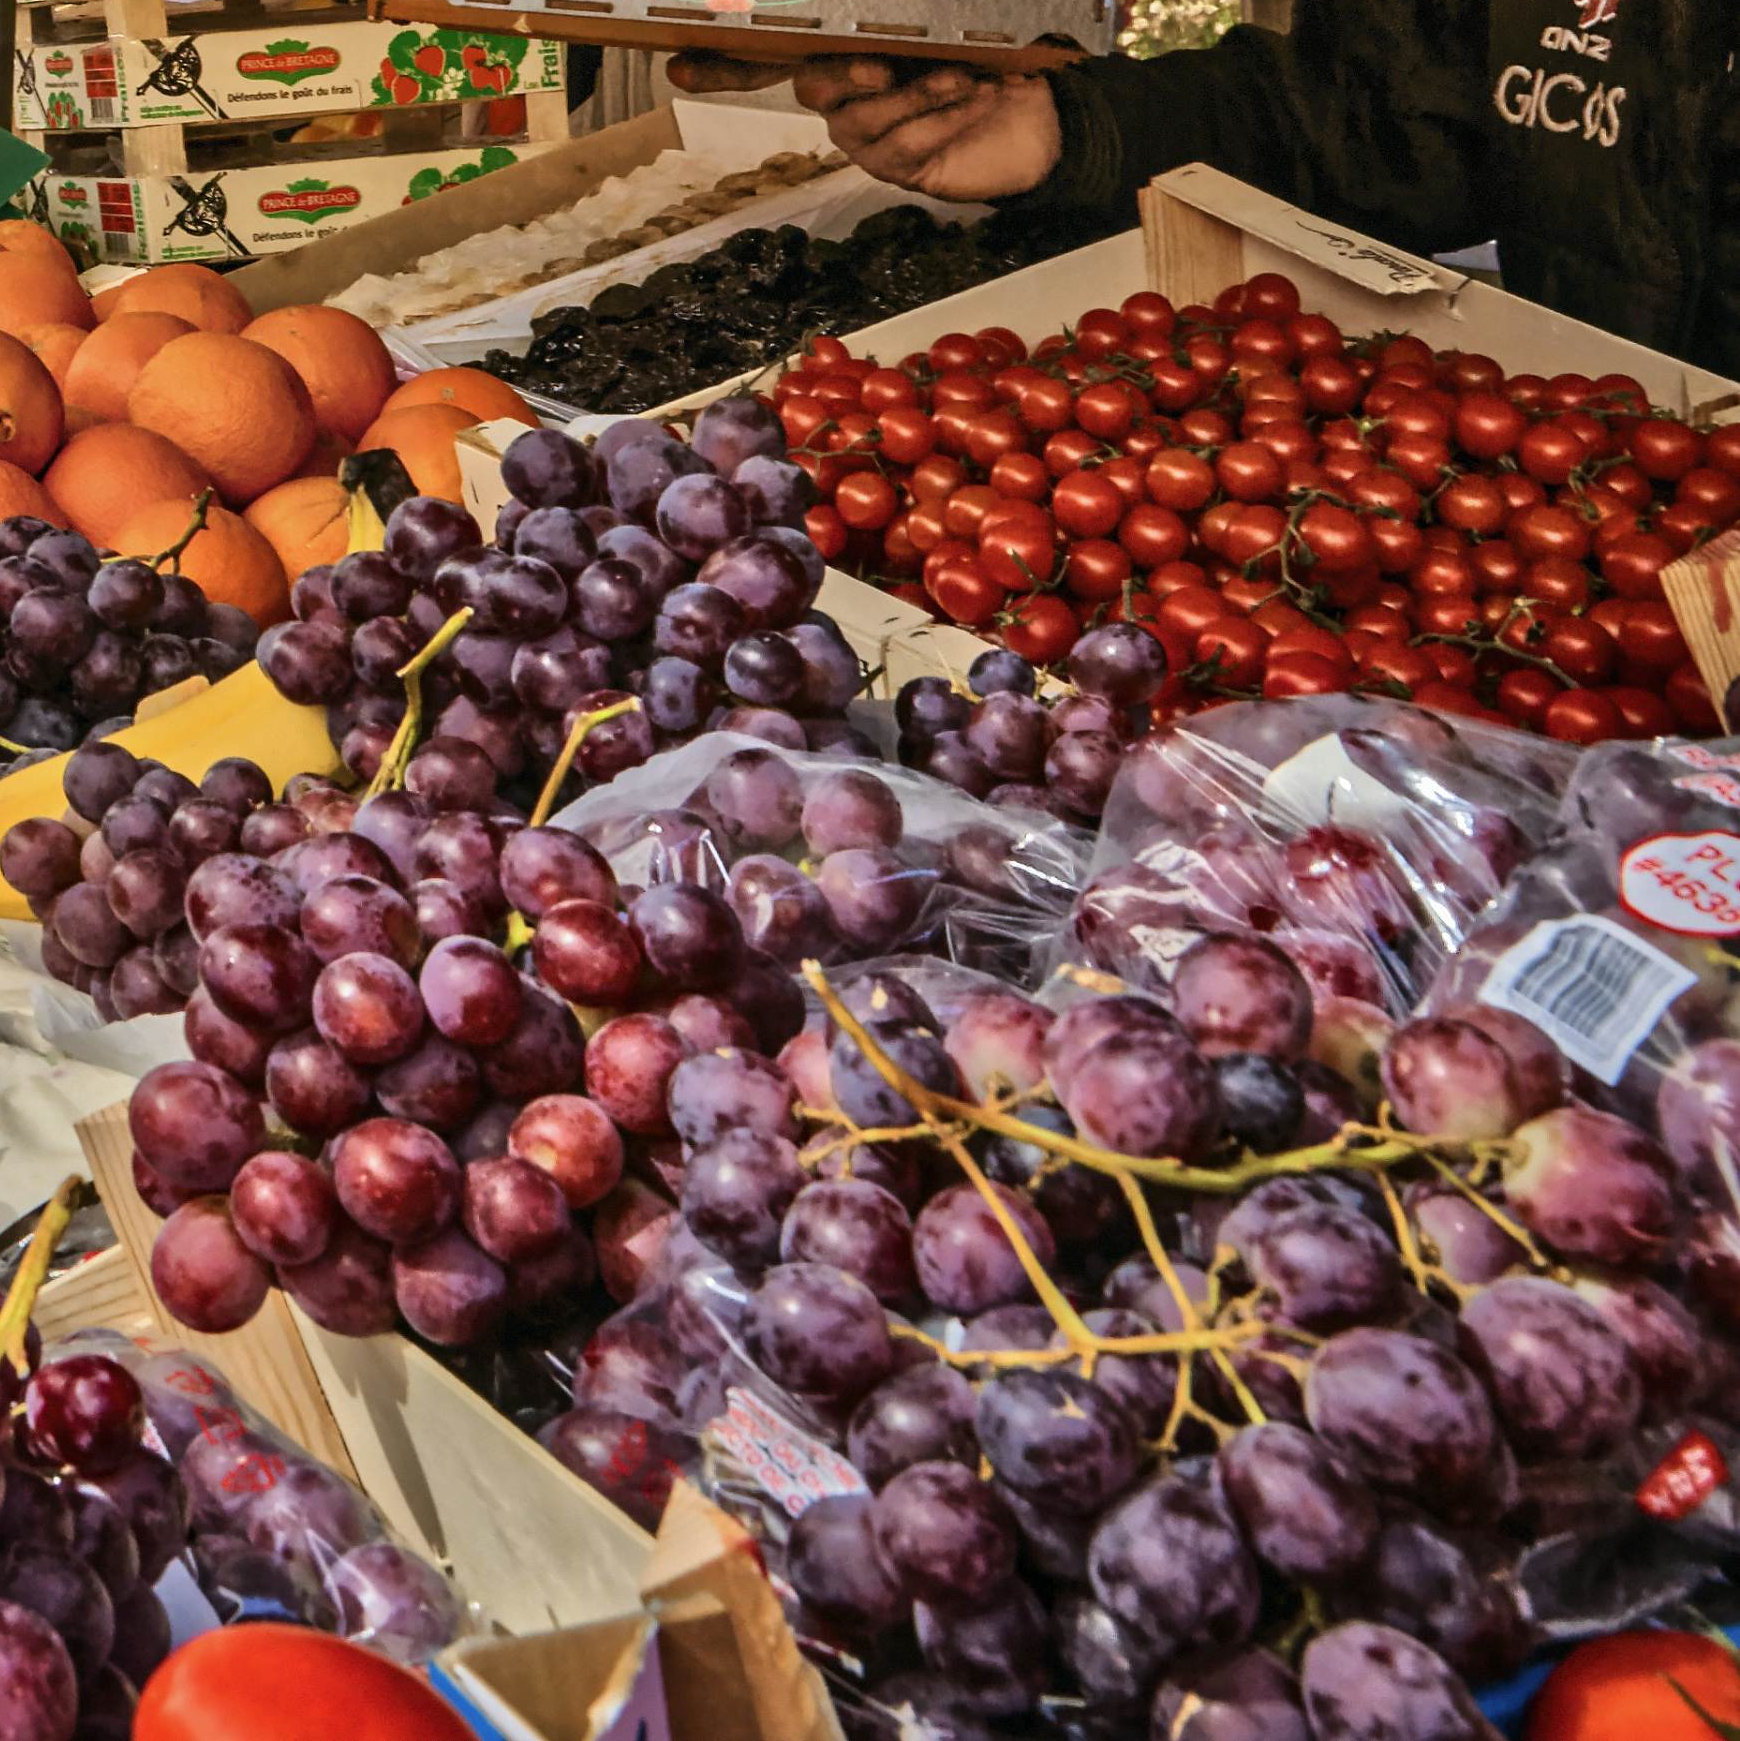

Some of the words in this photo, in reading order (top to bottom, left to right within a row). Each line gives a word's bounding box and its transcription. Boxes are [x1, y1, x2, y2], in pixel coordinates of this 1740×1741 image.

[227, 91, 278, 103] Défendons
[280, 89, 290, 100] le
[292, 87, 314, 101] goût
[316, 86, 329, 97] du
[331, 85, 353, 96] frais
[252, 230, 303, 243] Défendons
[1685, 843, 1740, 894] PL
